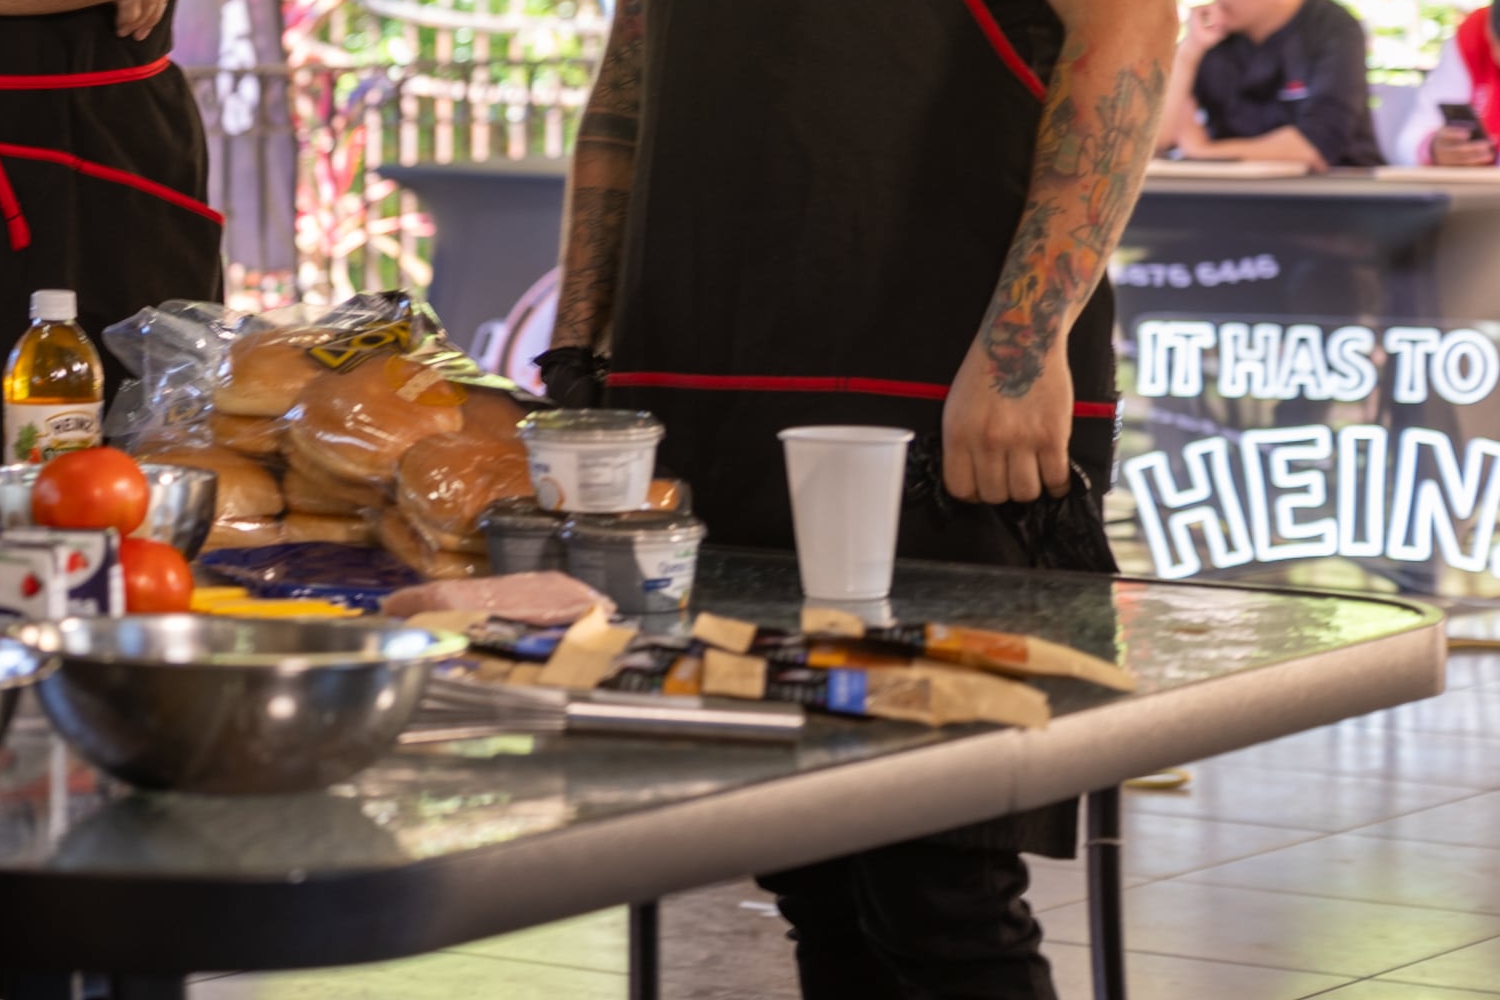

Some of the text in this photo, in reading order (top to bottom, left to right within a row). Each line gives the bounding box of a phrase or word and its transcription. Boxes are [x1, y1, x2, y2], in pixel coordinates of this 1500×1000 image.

[1137, 320, 1500, 405] IT HAS TO
[50, 416, 94, 437] HEINZ
[1124, 424, 1500, 580] HEIN
